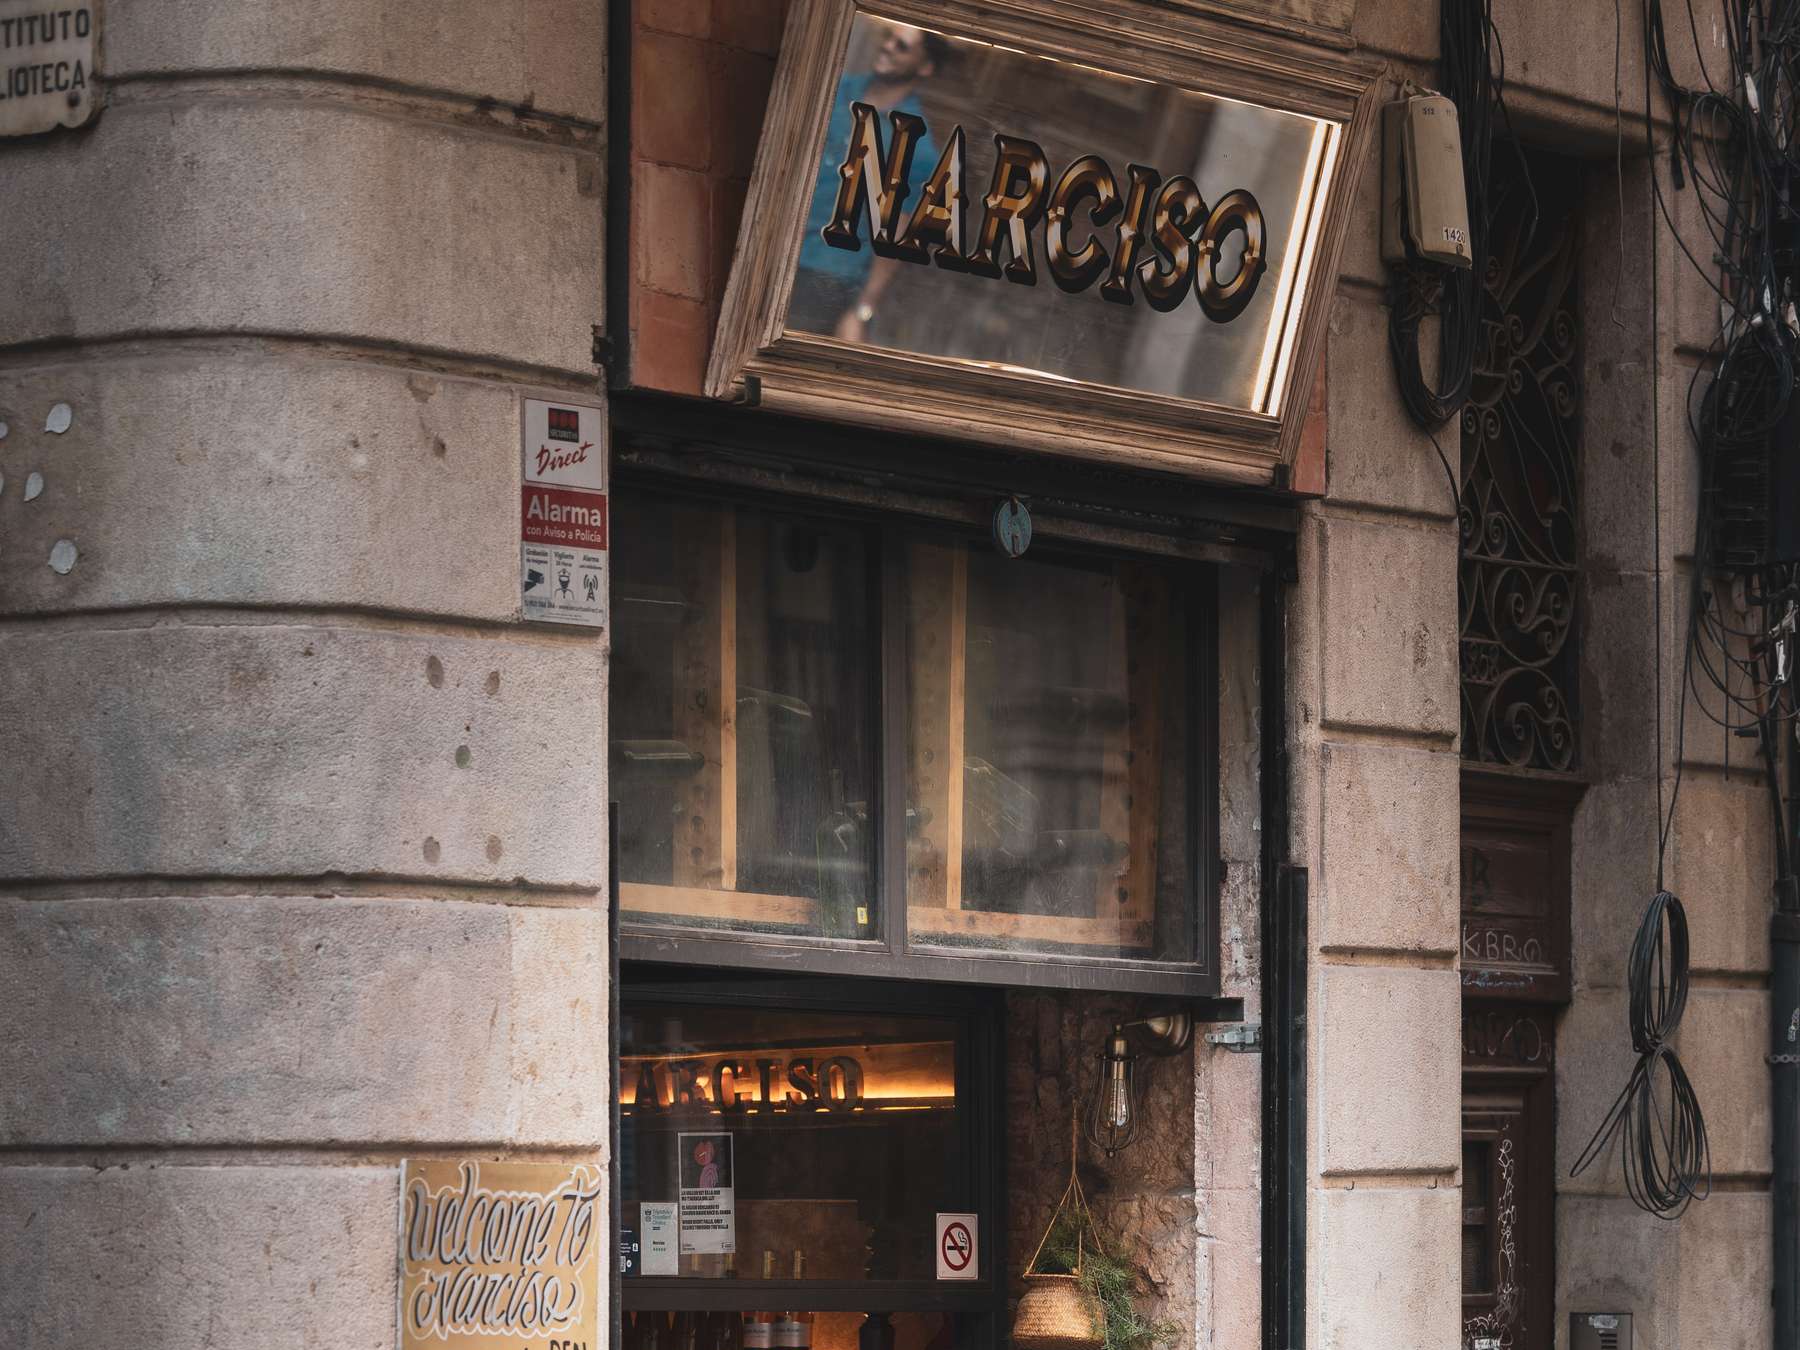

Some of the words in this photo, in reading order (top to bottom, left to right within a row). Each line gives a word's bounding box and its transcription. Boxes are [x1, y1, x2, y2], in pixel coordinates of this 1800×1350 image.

[0, 59, 85, 98] IOTECA
[821, 101, 1267, 324] NARCISO
[535, 440, 594, 476] Direct
[526, 494, 601, 527] Alarma
[526, 525, 541, 536] con
[543, 525, 567, 538] Aviso
[567, 530, 574, 540] a
